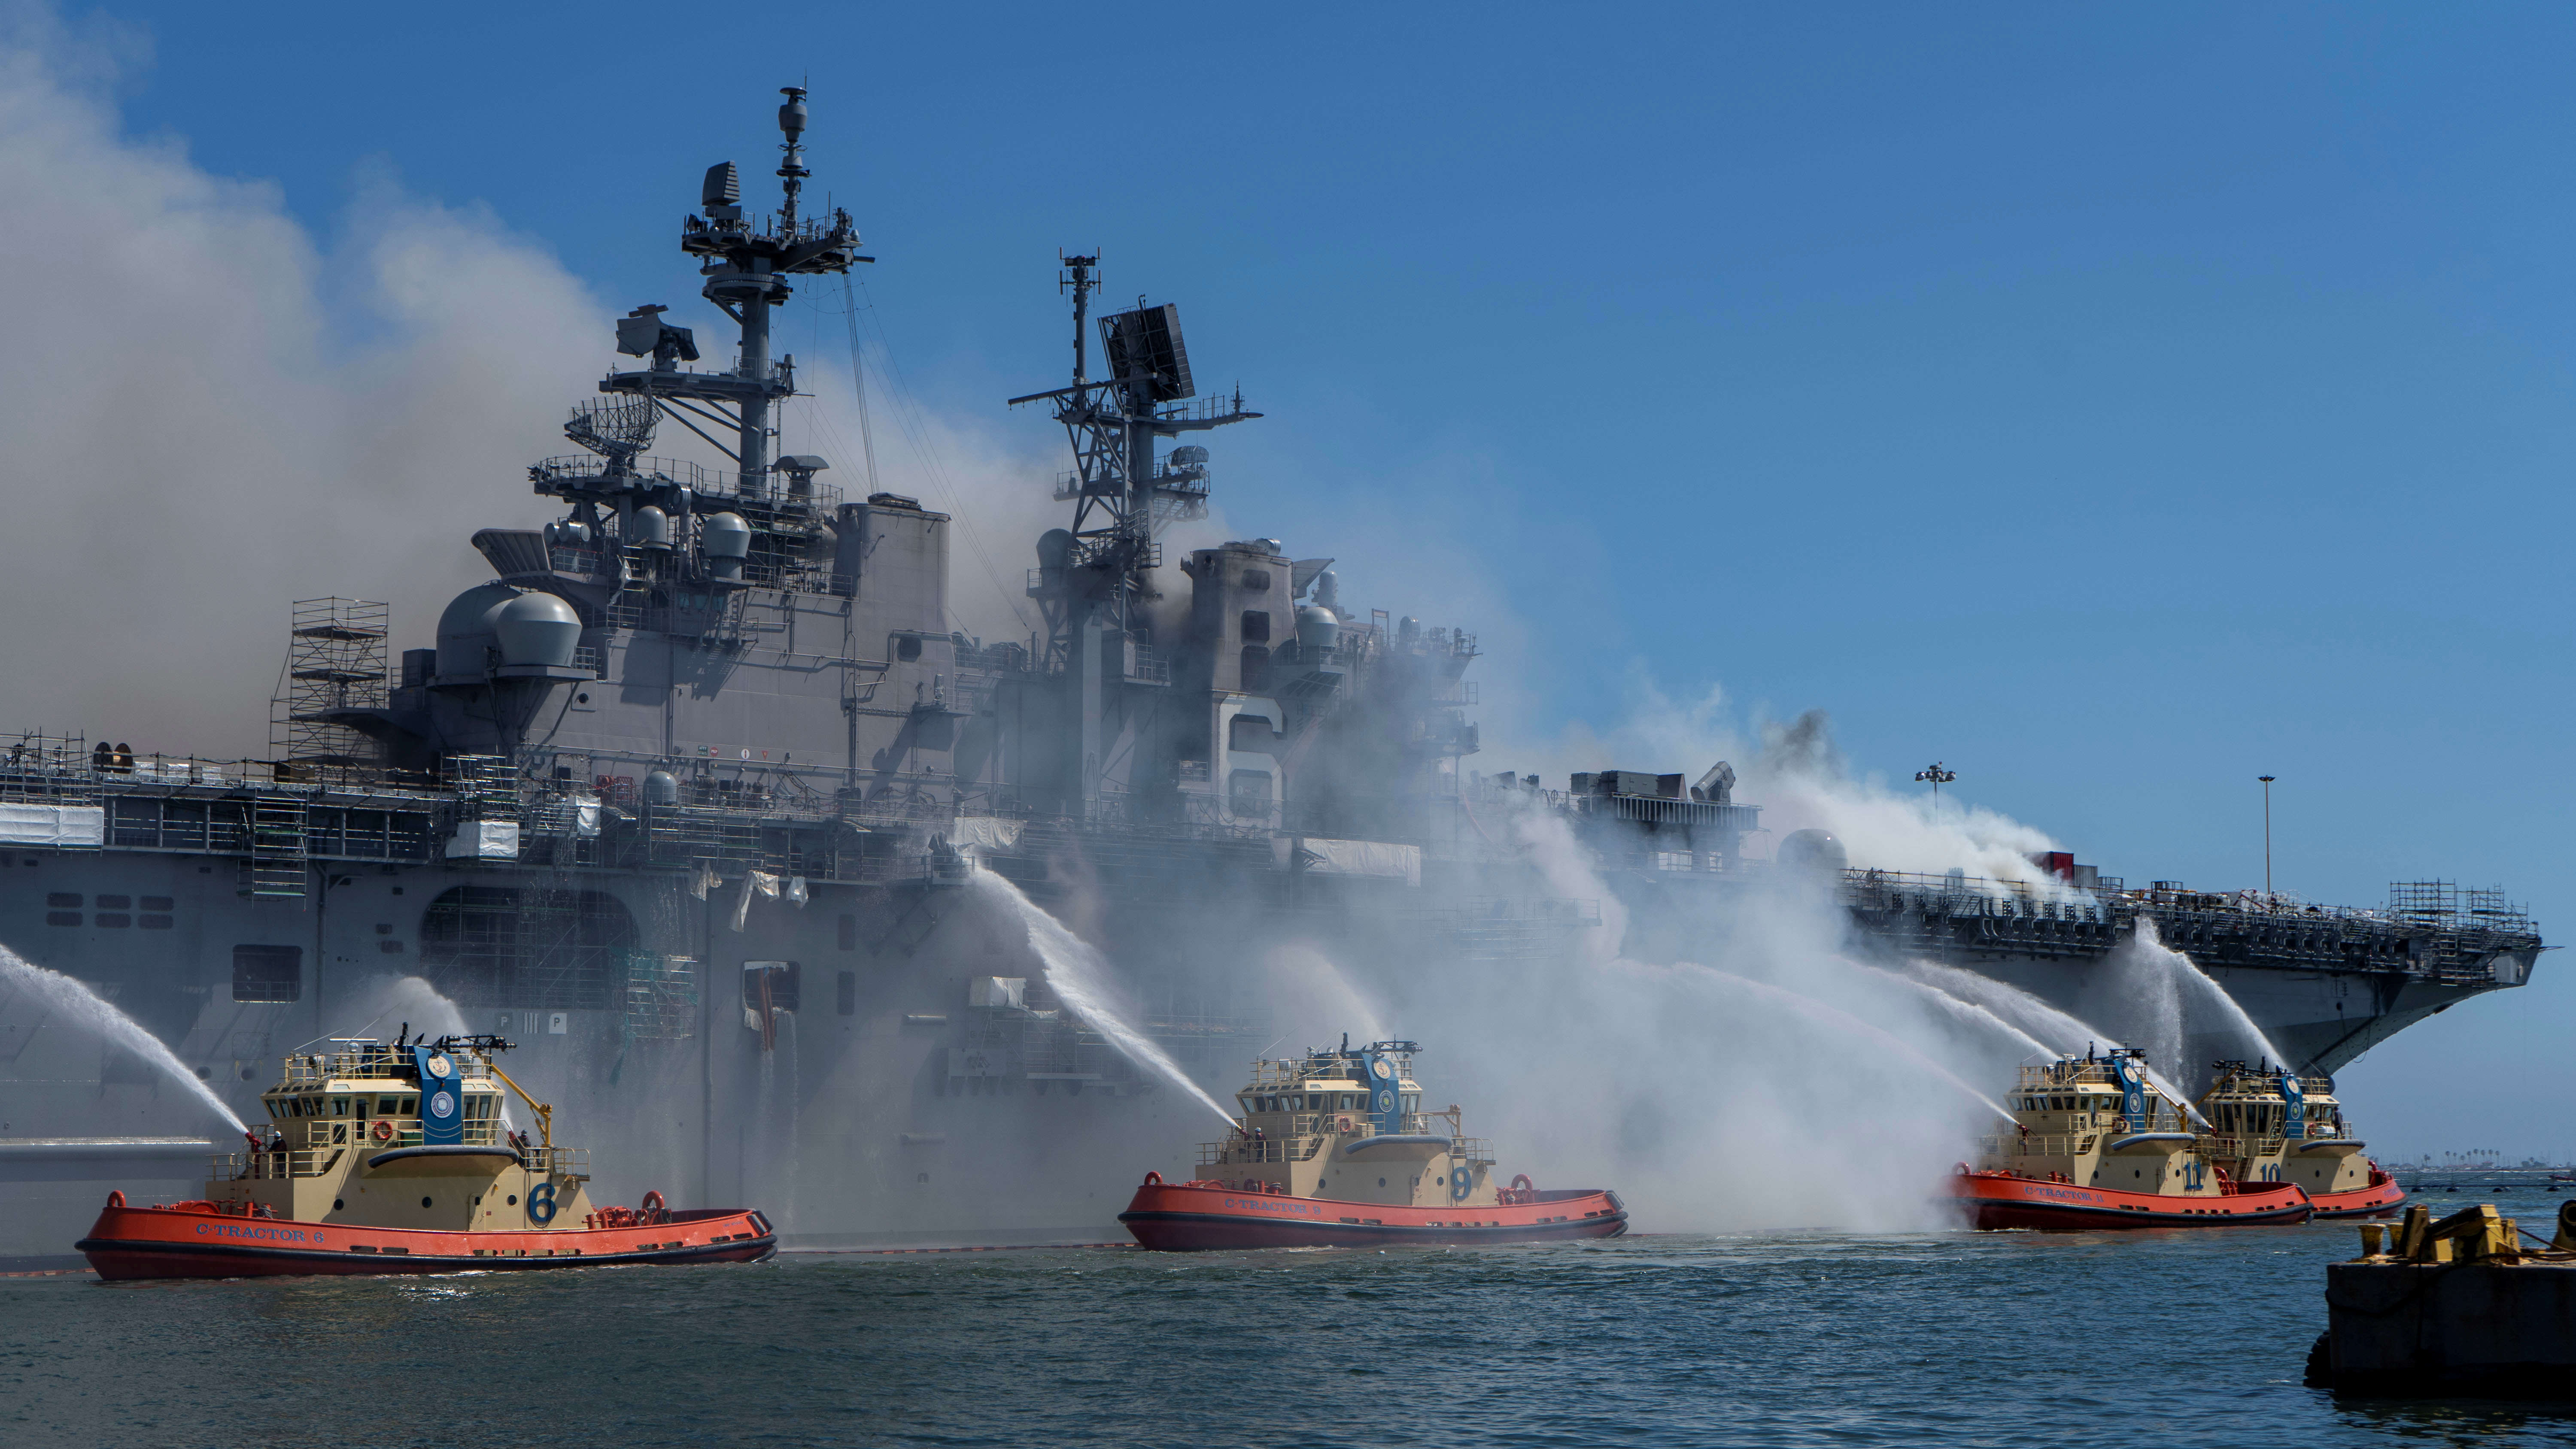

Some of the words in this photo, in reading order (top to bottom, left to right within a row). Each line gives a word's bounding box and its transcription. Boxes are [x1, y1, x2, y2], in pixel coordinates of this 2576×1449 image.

[1219, 694, 1283, 837] 6
[501, 1016, 508, 1027] P
[553, 1017, 560, 1028] P
[1452, 1166, 1472, 1201] 9
[2183, 1161, 2204, 1190] 11
[529, 1182, 556, 1222] 6
[2025, 1186, 2092, 1201] C-TRACTOR
[2095, 1193, 2104, 1202] 11
[1224, 1198, 1307, 1214] C-TRACTOR
[1312, 1205, 1321, 1215] 9
[196, 1223, 306, 1242] C-TRACTOR
[313, 1231, 325, 1243] 6
